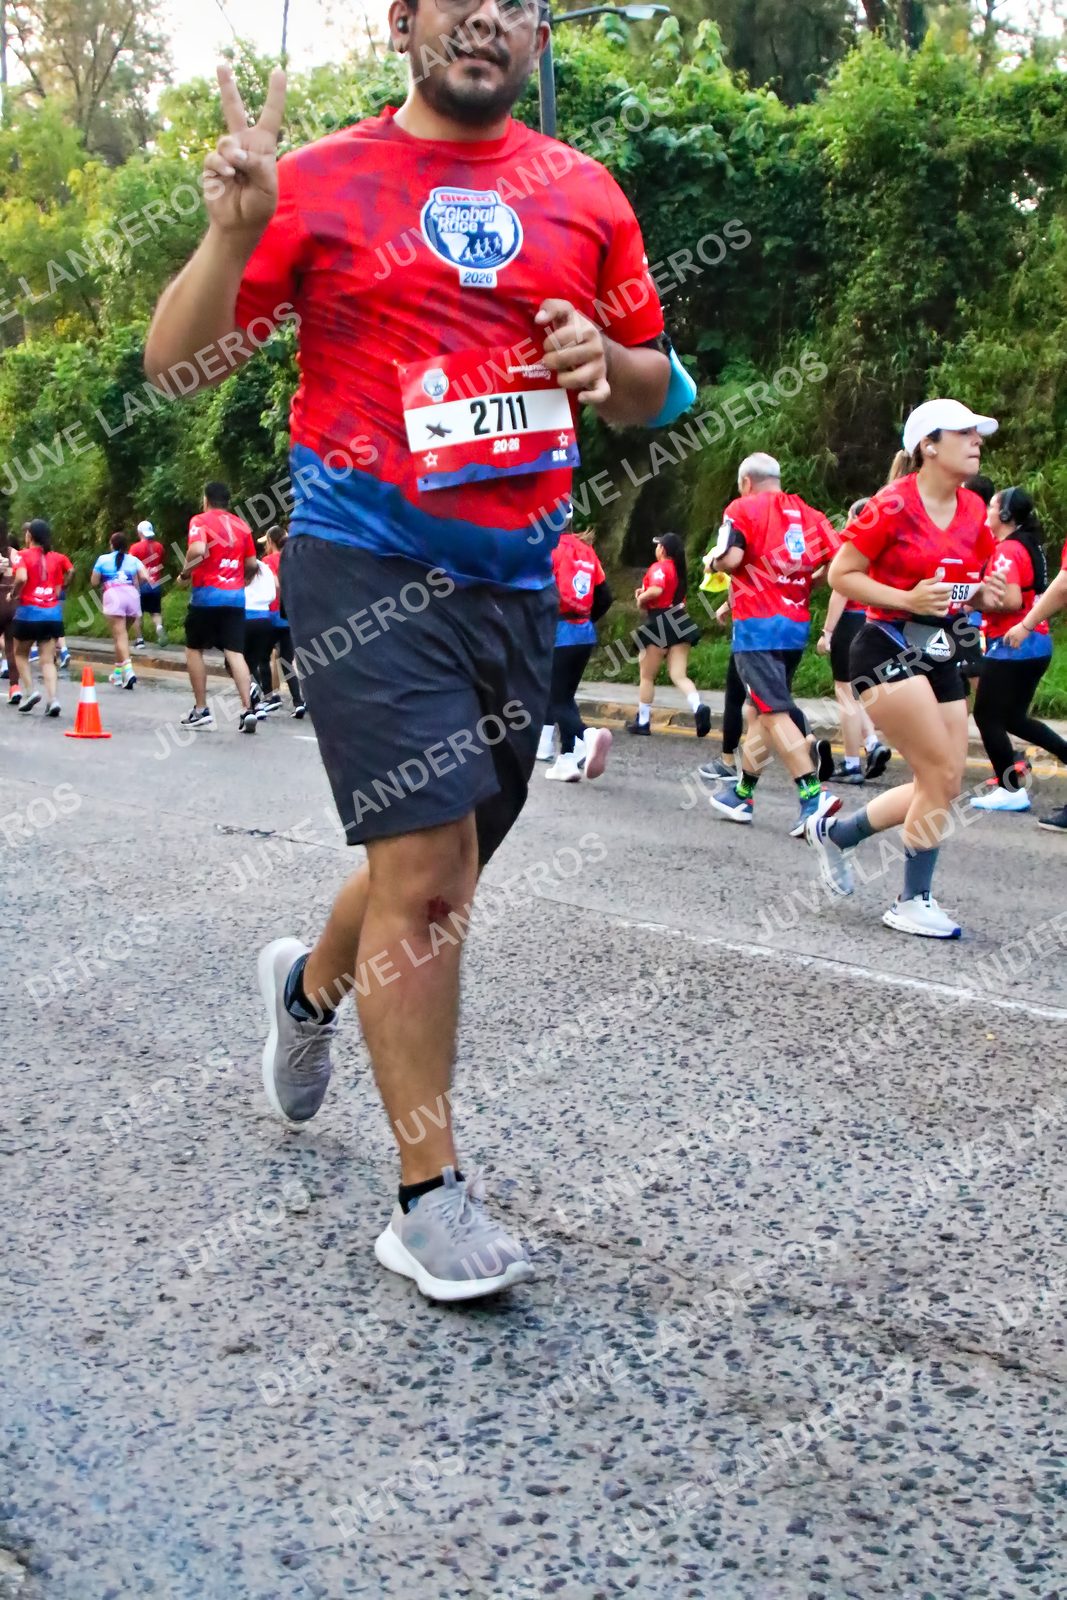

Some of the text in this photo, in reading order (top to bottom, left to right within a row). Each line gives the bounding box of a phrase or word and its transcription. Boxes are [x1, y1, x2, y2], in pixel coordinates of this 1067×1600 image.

[445, 206, 494, 222] Global
[438, 217, 478, 233] Race
[463, 271, 493, 284] 2026
[470, 395, 528, 436] 2711
